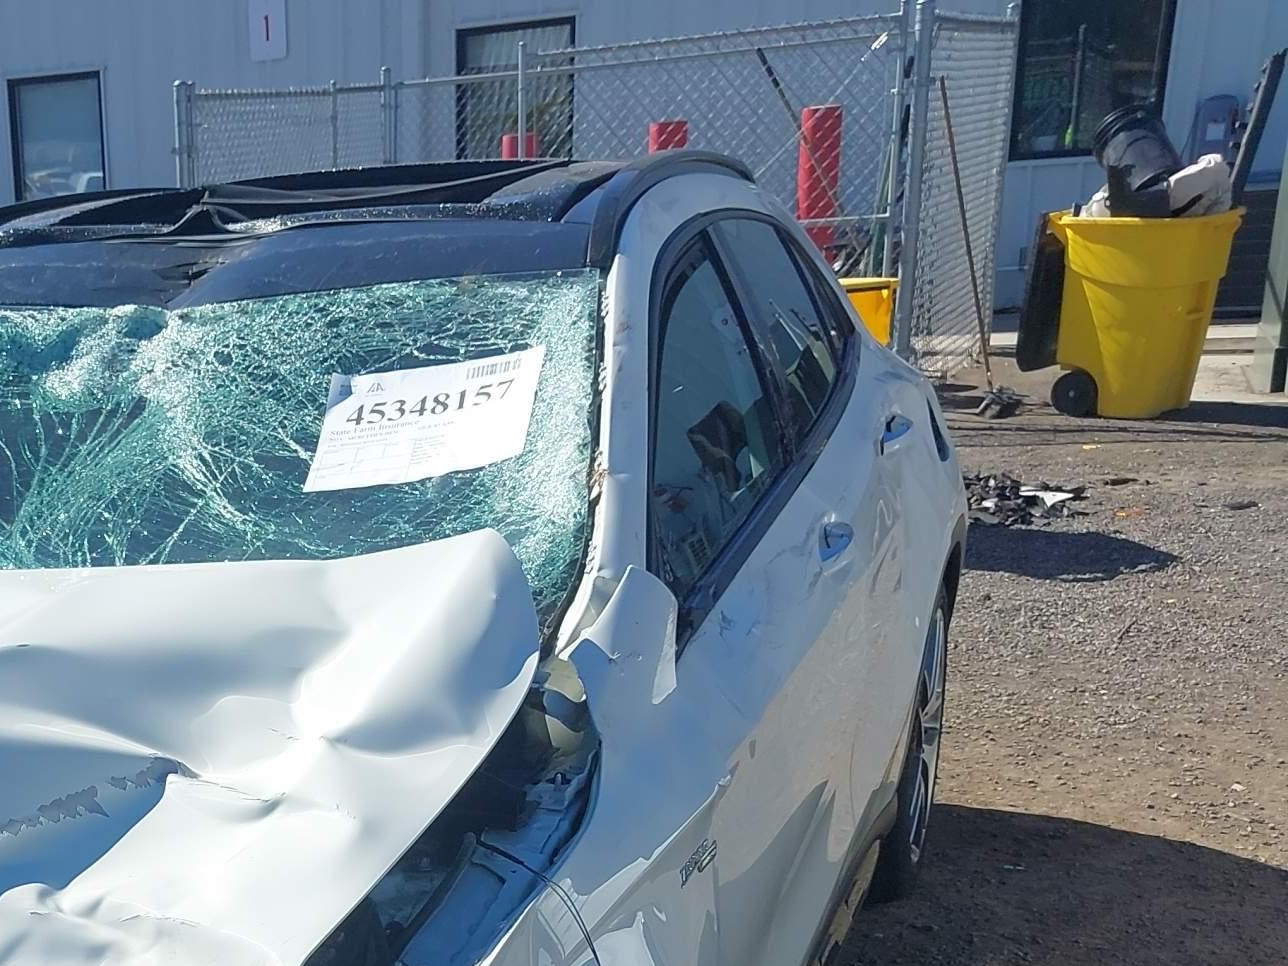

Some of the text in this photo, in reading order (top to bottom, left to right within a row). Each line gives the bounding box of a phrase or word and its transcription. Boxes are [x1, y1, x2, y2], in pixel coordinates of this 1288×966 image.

[263, 14, 271, 41] 1
[346, 379, 515, 426] 45348157
[354, 425, 376, 433] Farm
